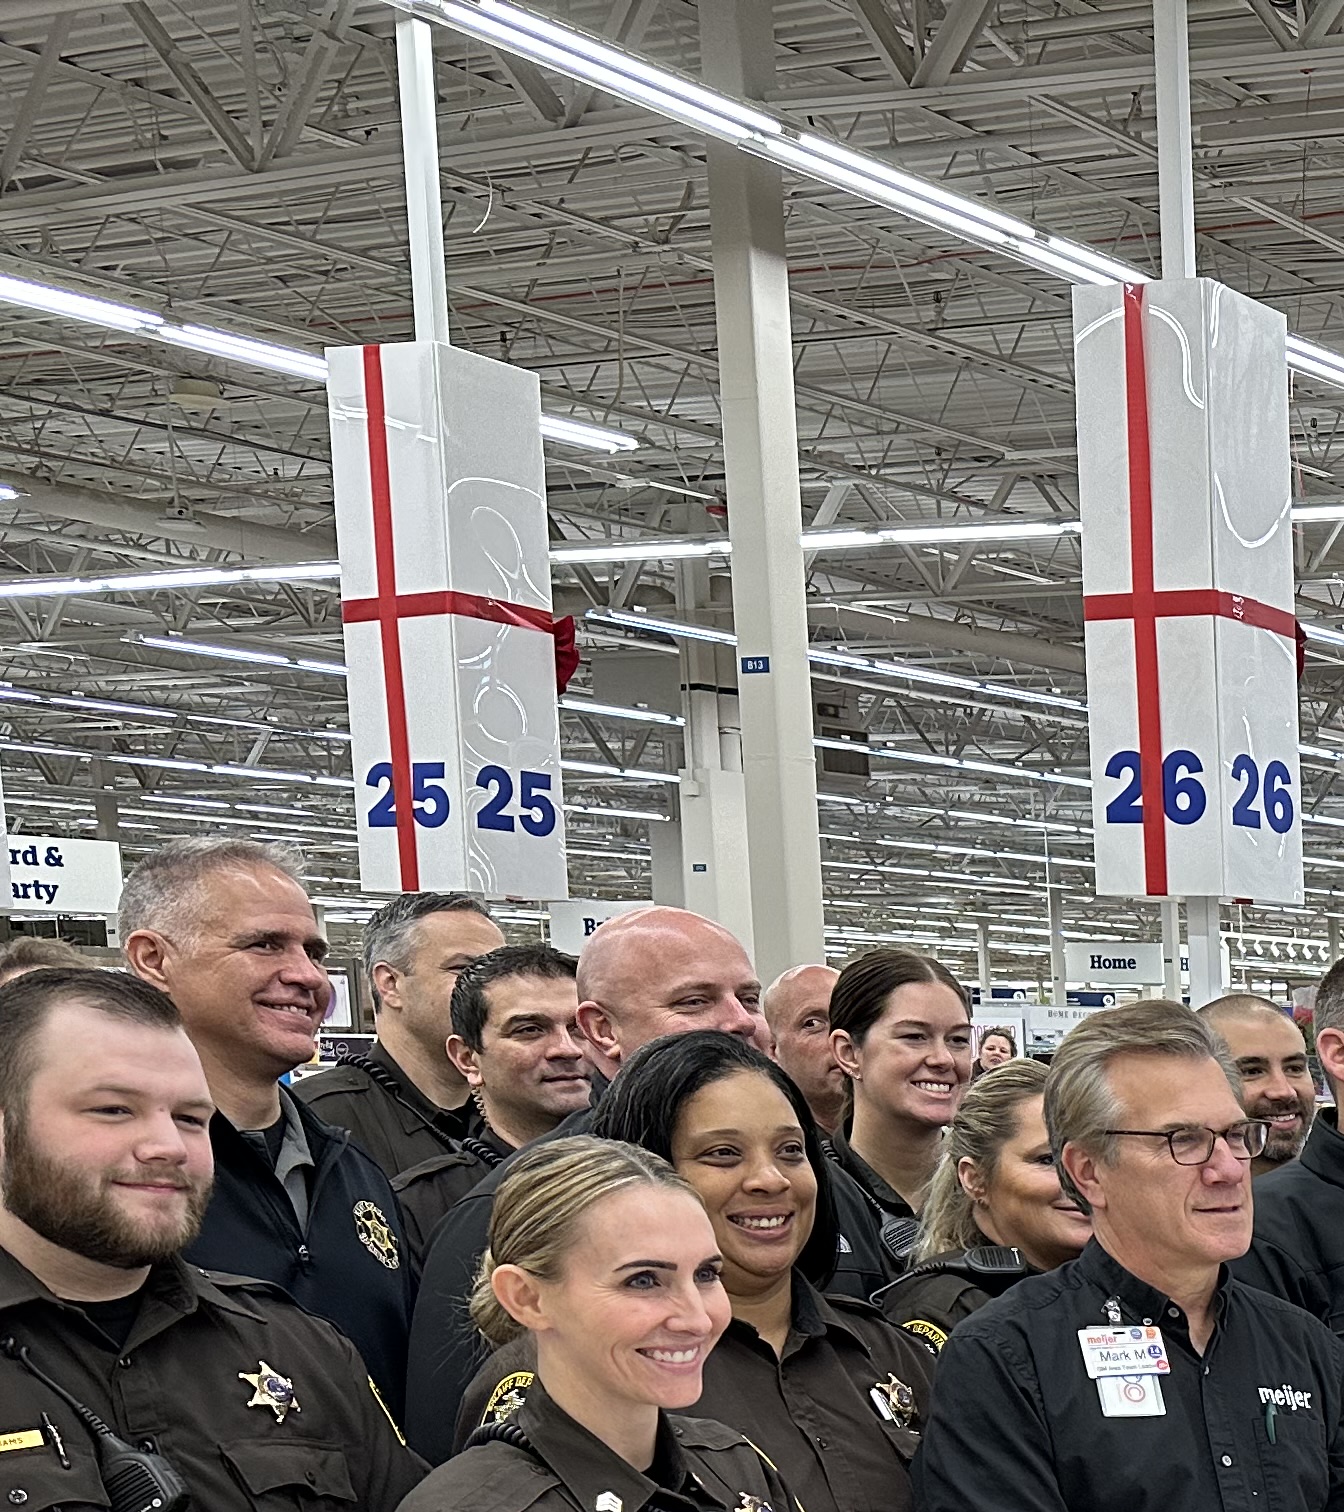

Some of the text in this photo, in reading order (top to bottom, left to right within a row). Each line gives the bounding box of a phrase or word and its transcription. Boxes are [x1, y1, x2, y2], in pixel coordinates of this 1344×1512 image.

[748, 660, 764, 670] B13
[366, 762, 450, 828] 25
[475, 765, 556, 837] 25
[1105, 750, 1206, 825] 26
[1231, 754, 1294, 834] 26
[9, 845, 65, 868] rd &
[11, 879, 60, 905] arty
[1089, 954, 1138, 970] Home
[1099, 1350, 1132, 1362] Mark
[1257, 1383, 1312, 1411] meijer
